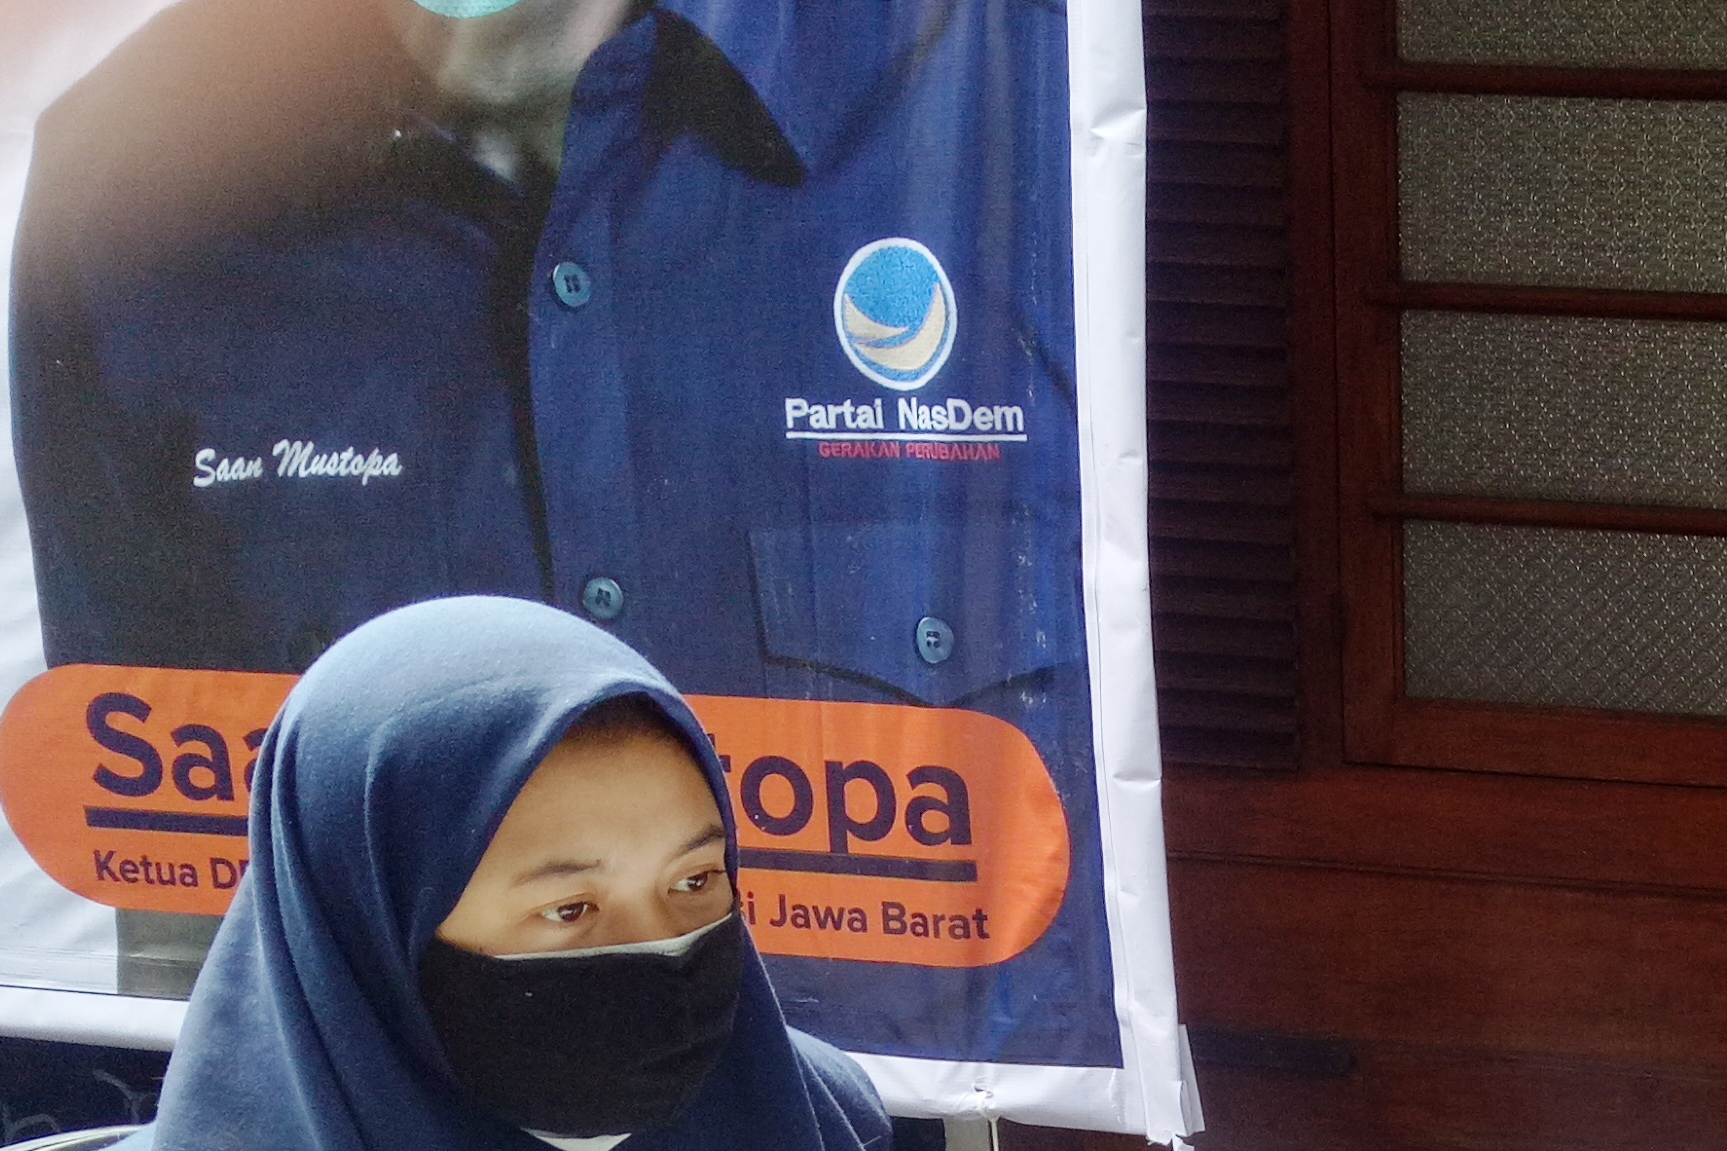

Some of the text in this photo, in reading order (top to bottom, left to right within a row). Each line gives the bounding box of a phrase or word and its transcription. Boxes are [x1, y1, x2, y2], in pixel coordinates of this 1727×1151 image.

[785, 396, 1025, 432] Partai NasDem
[193, 438, 403, 488] Saan Mustopa
[818, 441, 1002, 462] GERAKAN PERUBAHAN
[93, 849, 199, 888] Ketua
[768, 893, 869, 934] Jawa
[880, 900, 991, 940] Barat
